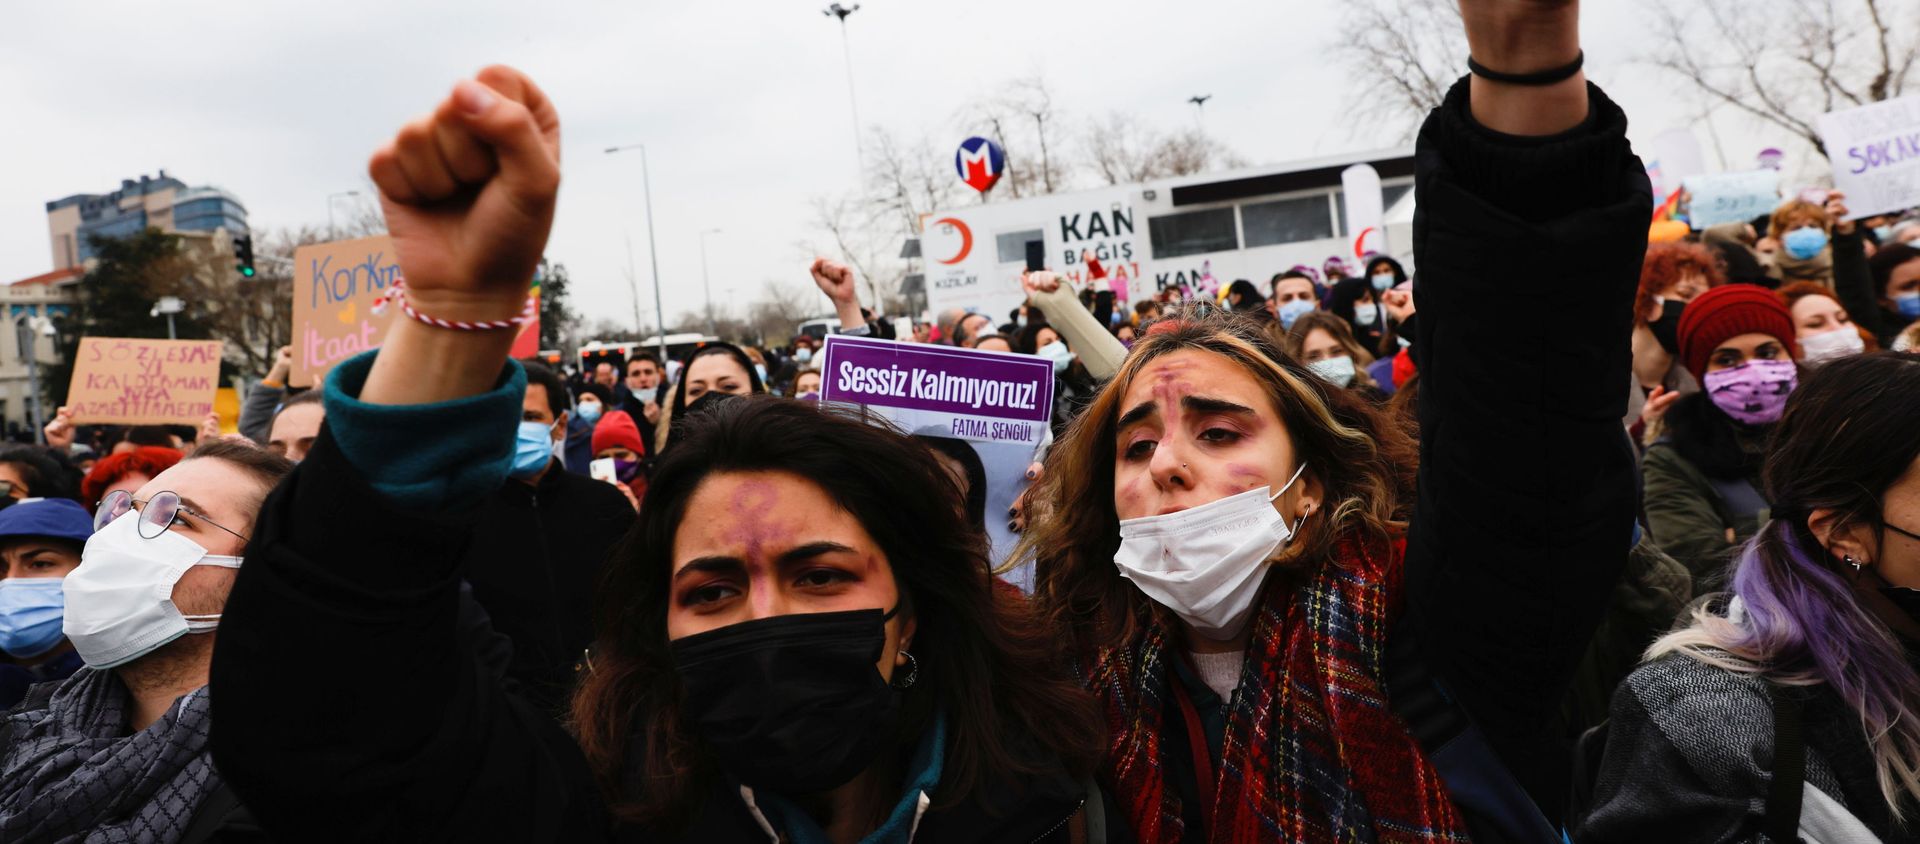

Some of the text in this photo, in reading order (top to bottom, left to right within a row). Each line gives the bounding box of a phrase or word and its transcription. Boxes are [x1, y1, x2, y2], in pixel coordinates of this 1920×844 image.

[959, 141, 994, 182] M
[1060, 206, 1134, 243] KAN
[311, 252, 402, 310] Korkm
[1066, 262, 1138, 284] HAT
[838, 360, 1039, 410] Sessiz Kalmıyoruz!
[952, 418, 1033, 442] FATMA ŞENGÜL
